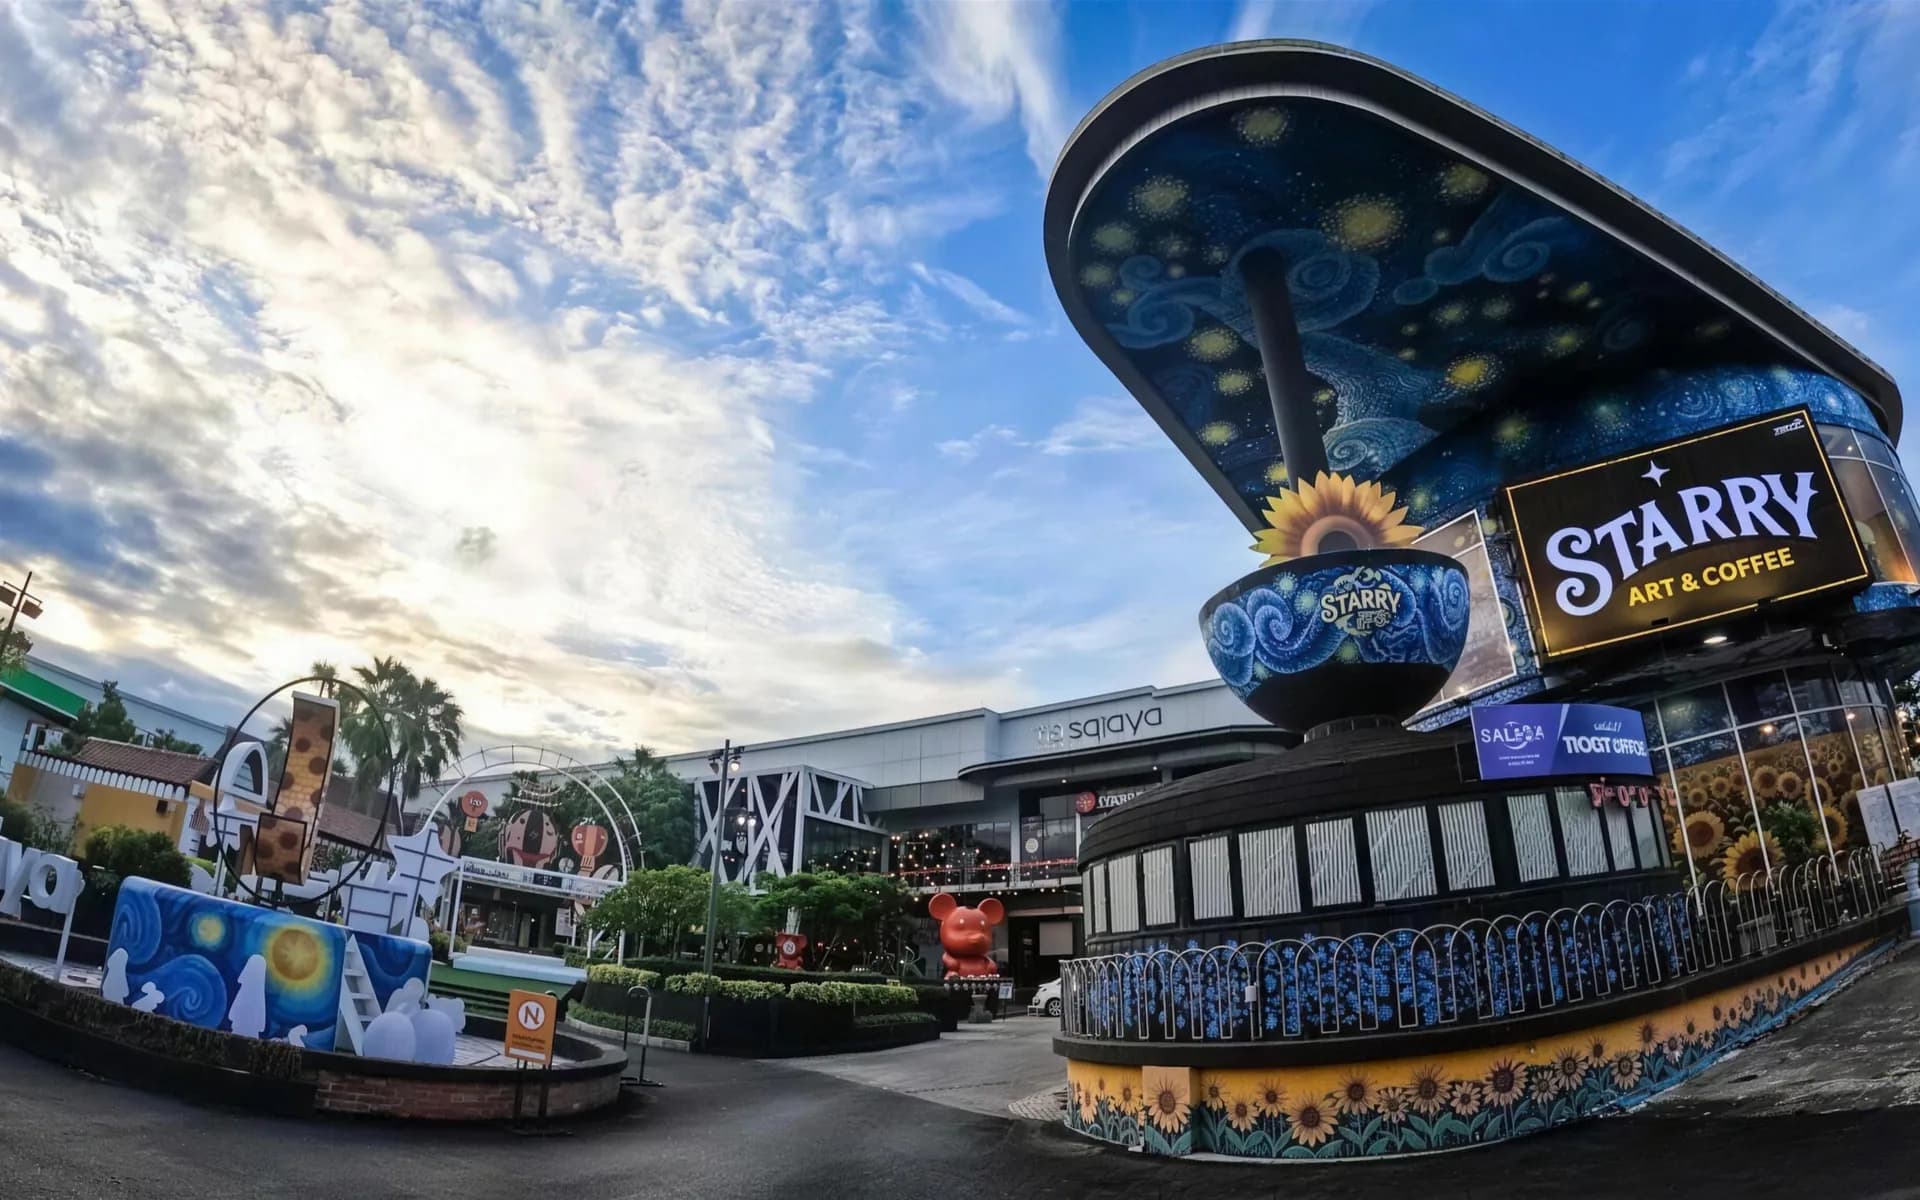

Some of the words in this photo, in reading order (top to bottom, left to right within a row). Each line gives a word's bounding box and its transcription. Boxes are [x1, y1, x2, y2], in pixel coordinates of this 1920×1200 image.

[1546, 471, 1818, 616] STARRY
[1321, 589, 1401, 623] STARRY
[1628, 577, 1675, 607] ART
[1681, 573, 1699, 593] &
[1703, 547, 1795, 586] COFFEE
